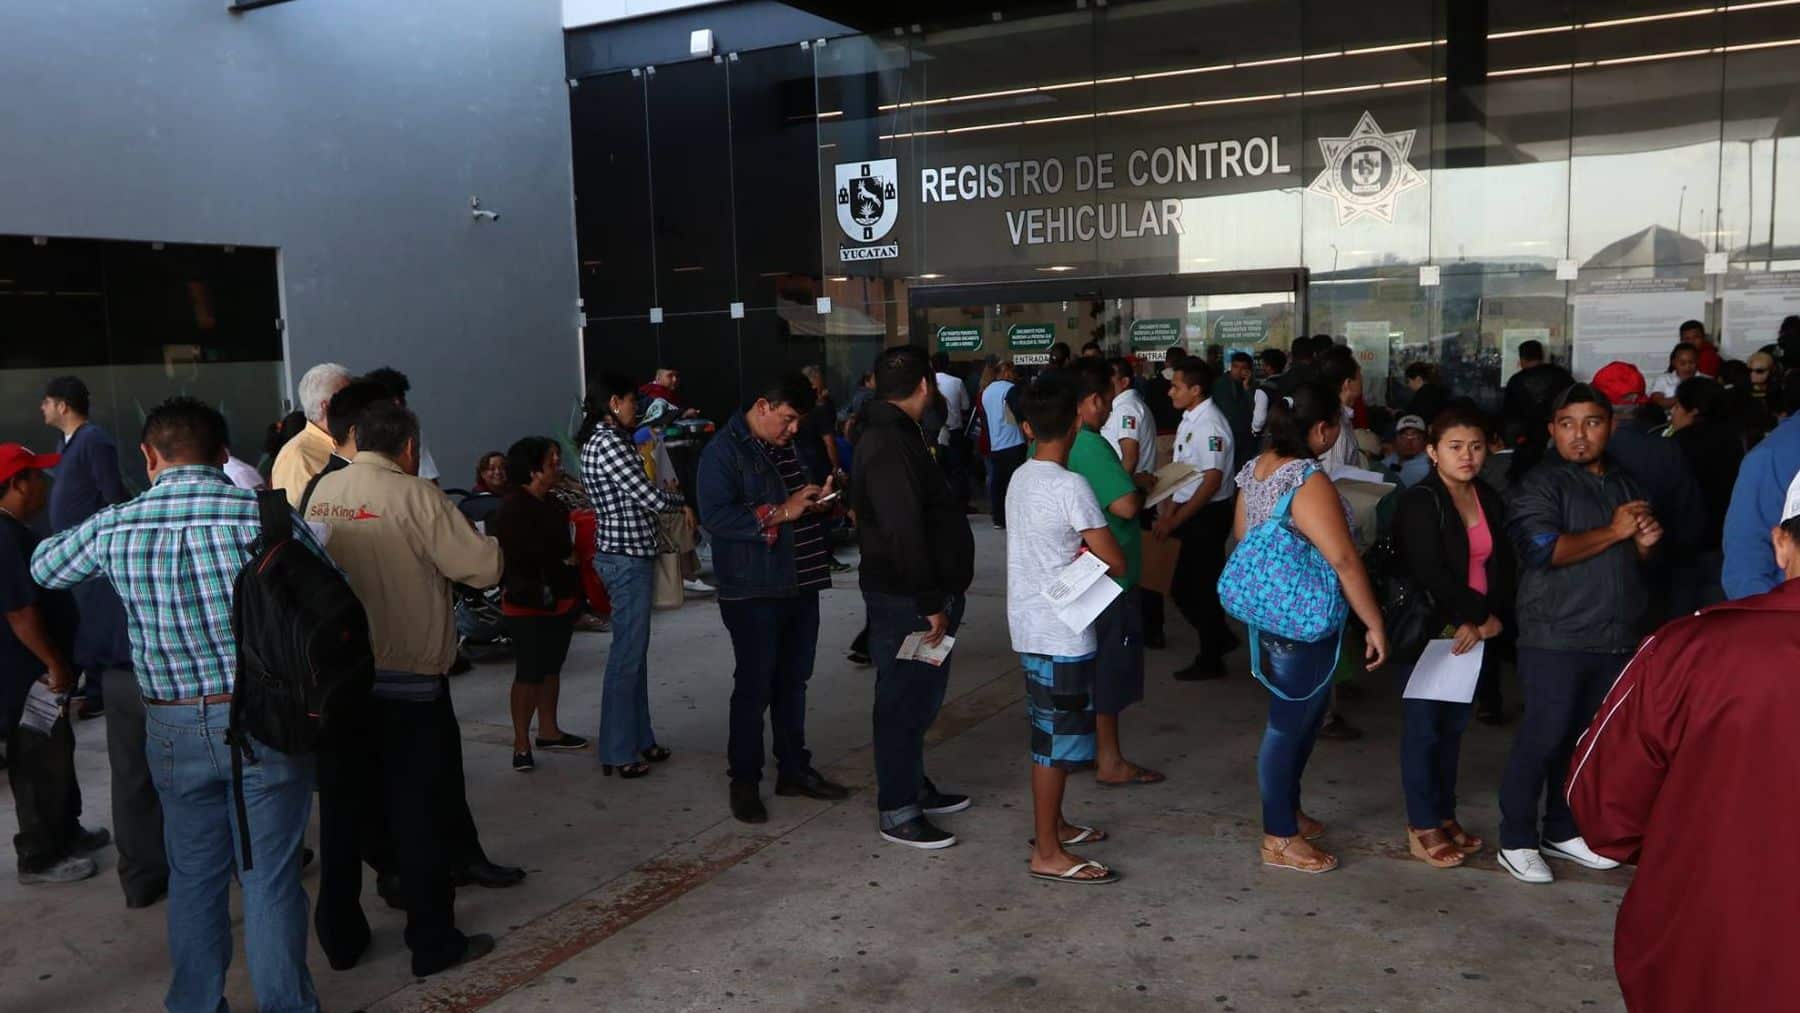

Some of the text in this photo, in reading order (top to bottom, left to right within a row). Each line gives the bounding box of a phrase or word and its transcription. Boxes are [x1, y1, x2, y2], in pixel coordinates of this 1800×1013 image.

[921, 158, 1064, 203] REGISTRO
[1075, 153, 1115, 192] DE
[1128, 136, 1291, 186] CONTROL
[1005, 198, 1186, 246] VEHICULAR
[842, 246, 897, 259] YUCATAN
[1015, 354, 1049, 363] ENTRADA
[332, 504, 355, 520] King
